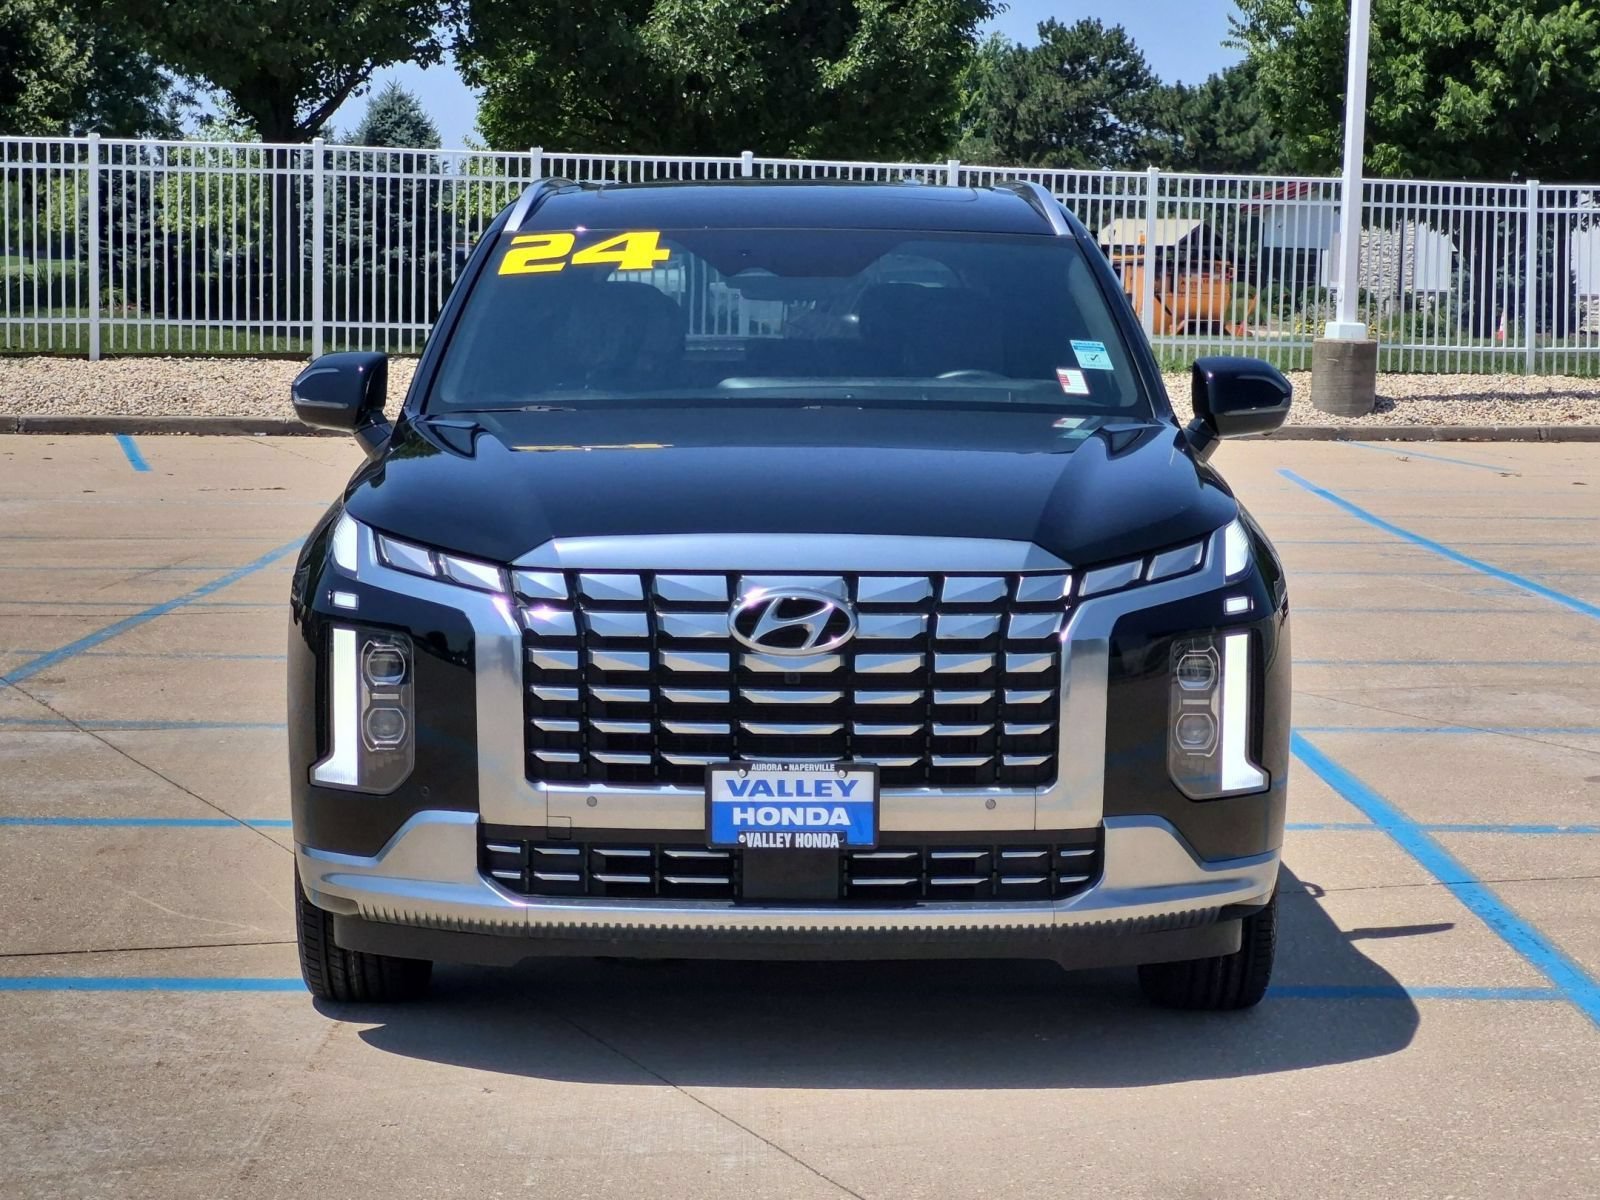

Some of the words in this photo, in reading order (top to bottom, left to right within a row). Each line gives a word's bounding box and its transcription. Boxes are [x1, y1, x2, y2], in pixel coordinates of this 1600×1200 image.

[498, 231, 670, 275] 24
[751, 763, 783, 772] AURORA
[789, 763, 835, 772] NAPERVILLE
[726, 779, 859, 797] VALLEY
[732, 807, 850, 826] HONDA
[746, 832, 792, 848] VALLEY
[794, 833, 840, 848] HONDA
